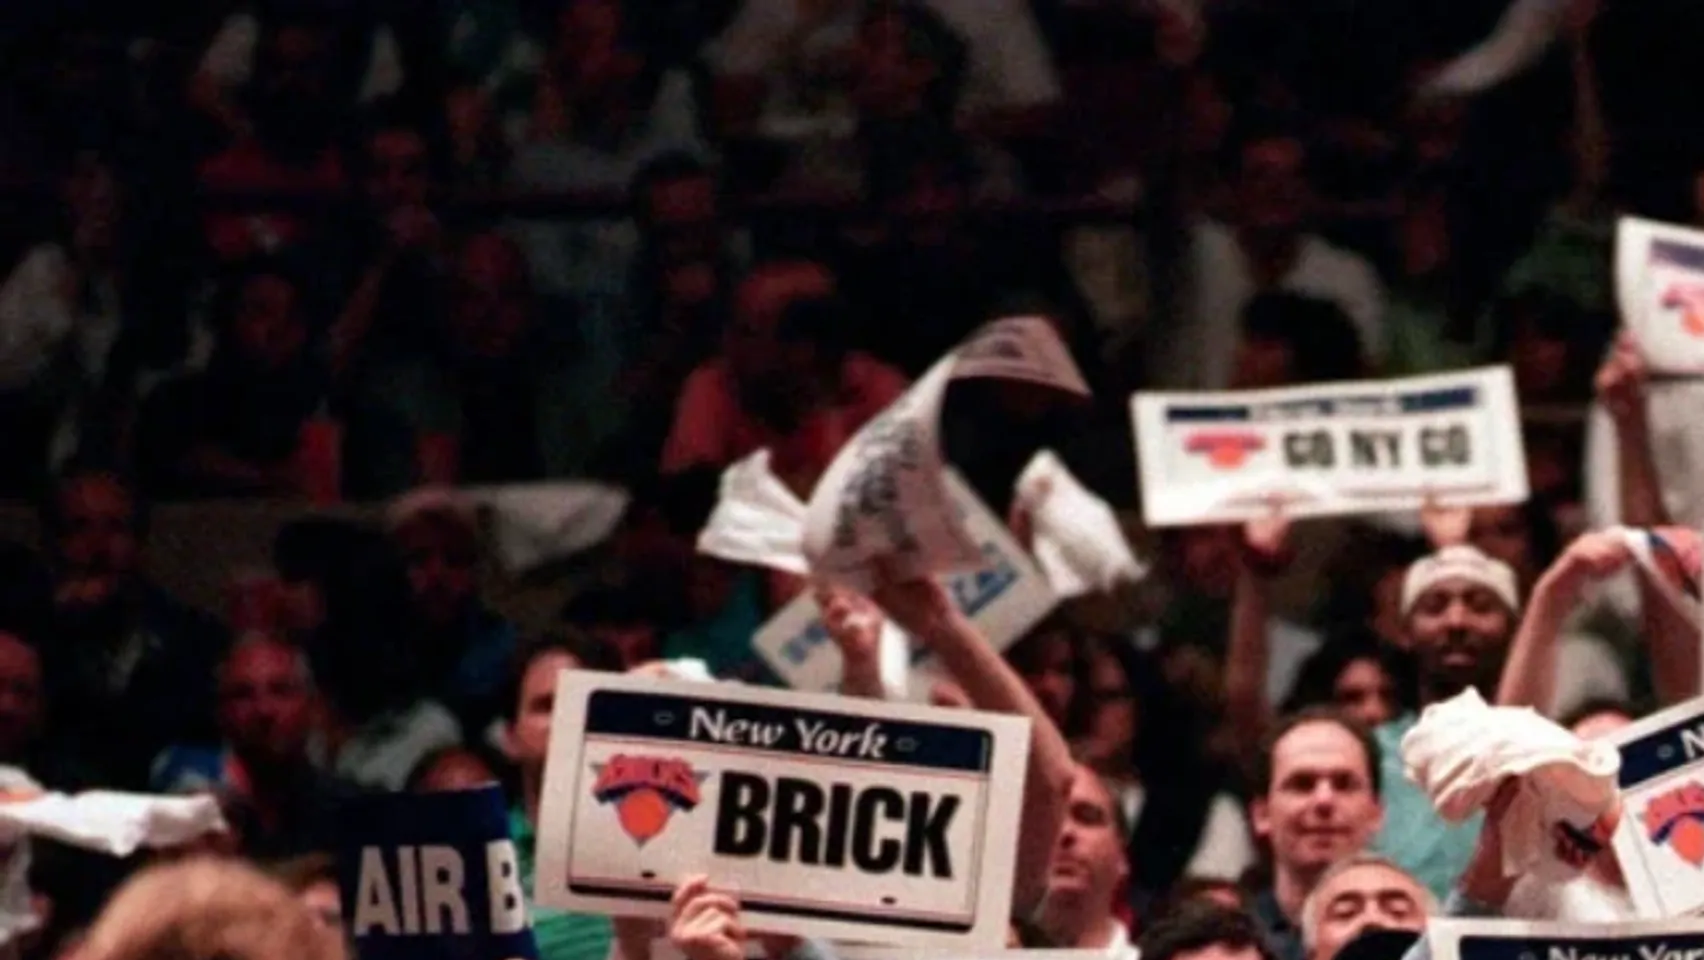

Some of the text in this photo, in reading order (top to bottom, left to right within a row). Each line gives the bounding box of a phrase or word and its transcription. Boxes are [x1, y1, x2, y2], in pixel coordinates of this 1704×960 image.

[1349, 430, 1401, 468] NY
[690, 708, 888, 758] New York
[714, 770, 961, 879] BRICK
[354, 845, 471, 936] AIR
